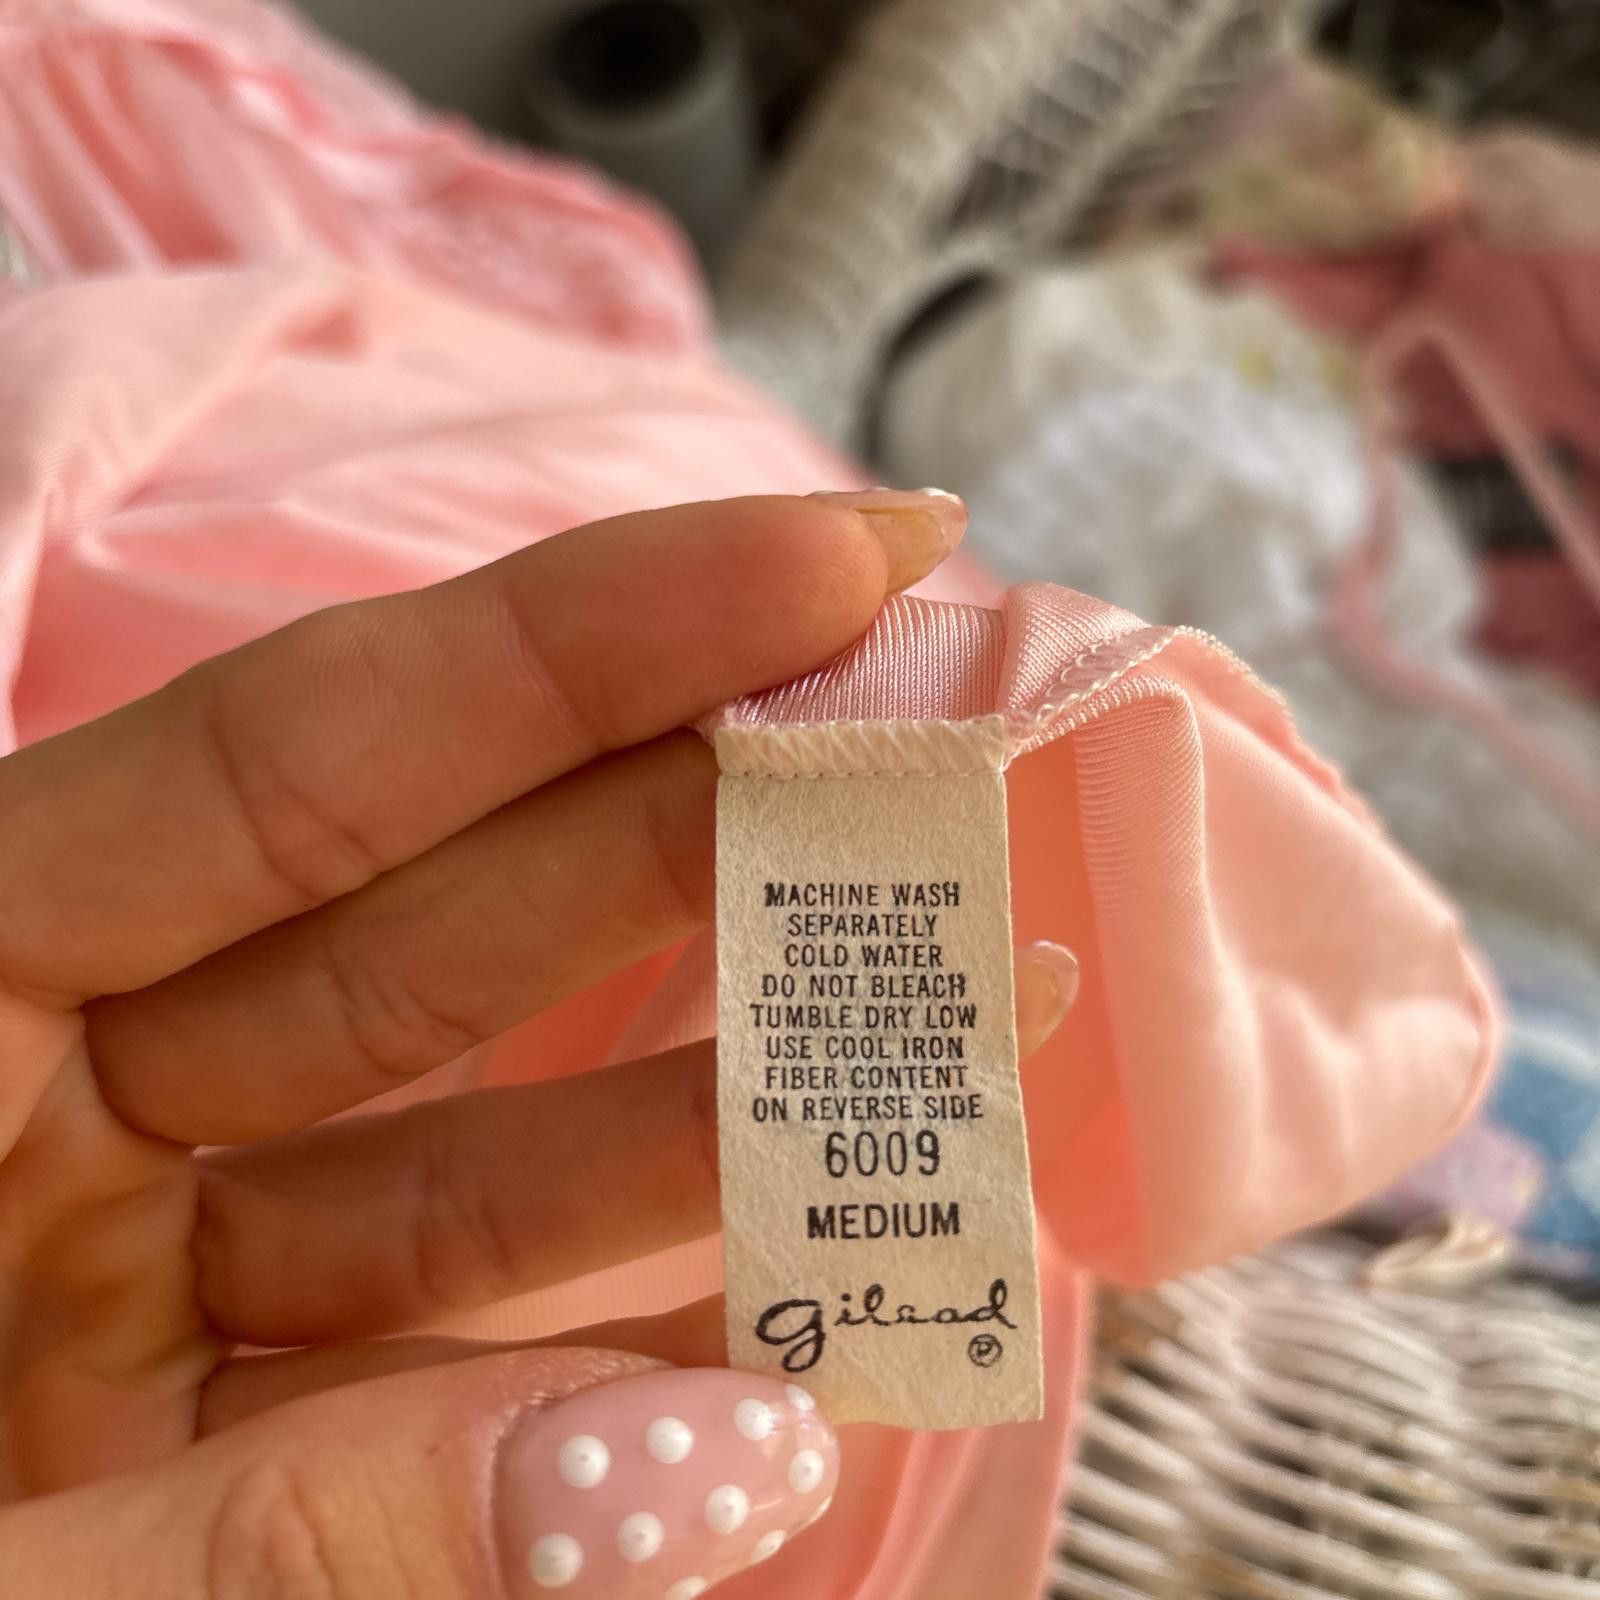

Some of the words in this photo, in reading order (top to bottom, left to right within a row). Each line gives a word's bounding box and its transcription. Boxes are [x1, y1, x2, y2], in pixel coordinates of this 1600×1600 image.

[764, 882, 879, 907] MACHINE
[891, 881, 960, 907] WASH
[787, 913, 937, 938] SEPARATELY
[784, 944, 849, 968] COLD
[861, 944, 943, 968] WATER
[762, 974, 795, 998] DO
[810, 974, 858, 998] NOT
[871, 973, 966, 998] BLEACH
[749, 1003, 853, 1029] TUMBLE
[865, 1005, 913, 1029] DRY
[925, 1003, 977, 1029] LOW
[766, 1036, 813, 1060] USE
[825, 1036, 891, 1060] COOL
[902, 1036, 964, 1060] IRON
[765, 1066, 838, 1090] FIBER
[851, 1065, 968, 1090] CONTENT
[752, 1097, 788, 1122] ON
[802, 1095, 914, 1122] REVERSE
[924, 1094, 984, 1120] SIDE
[825, 1130, 940, 1178] 6009
[807, 1202, 960, 1239] MEDIUM
